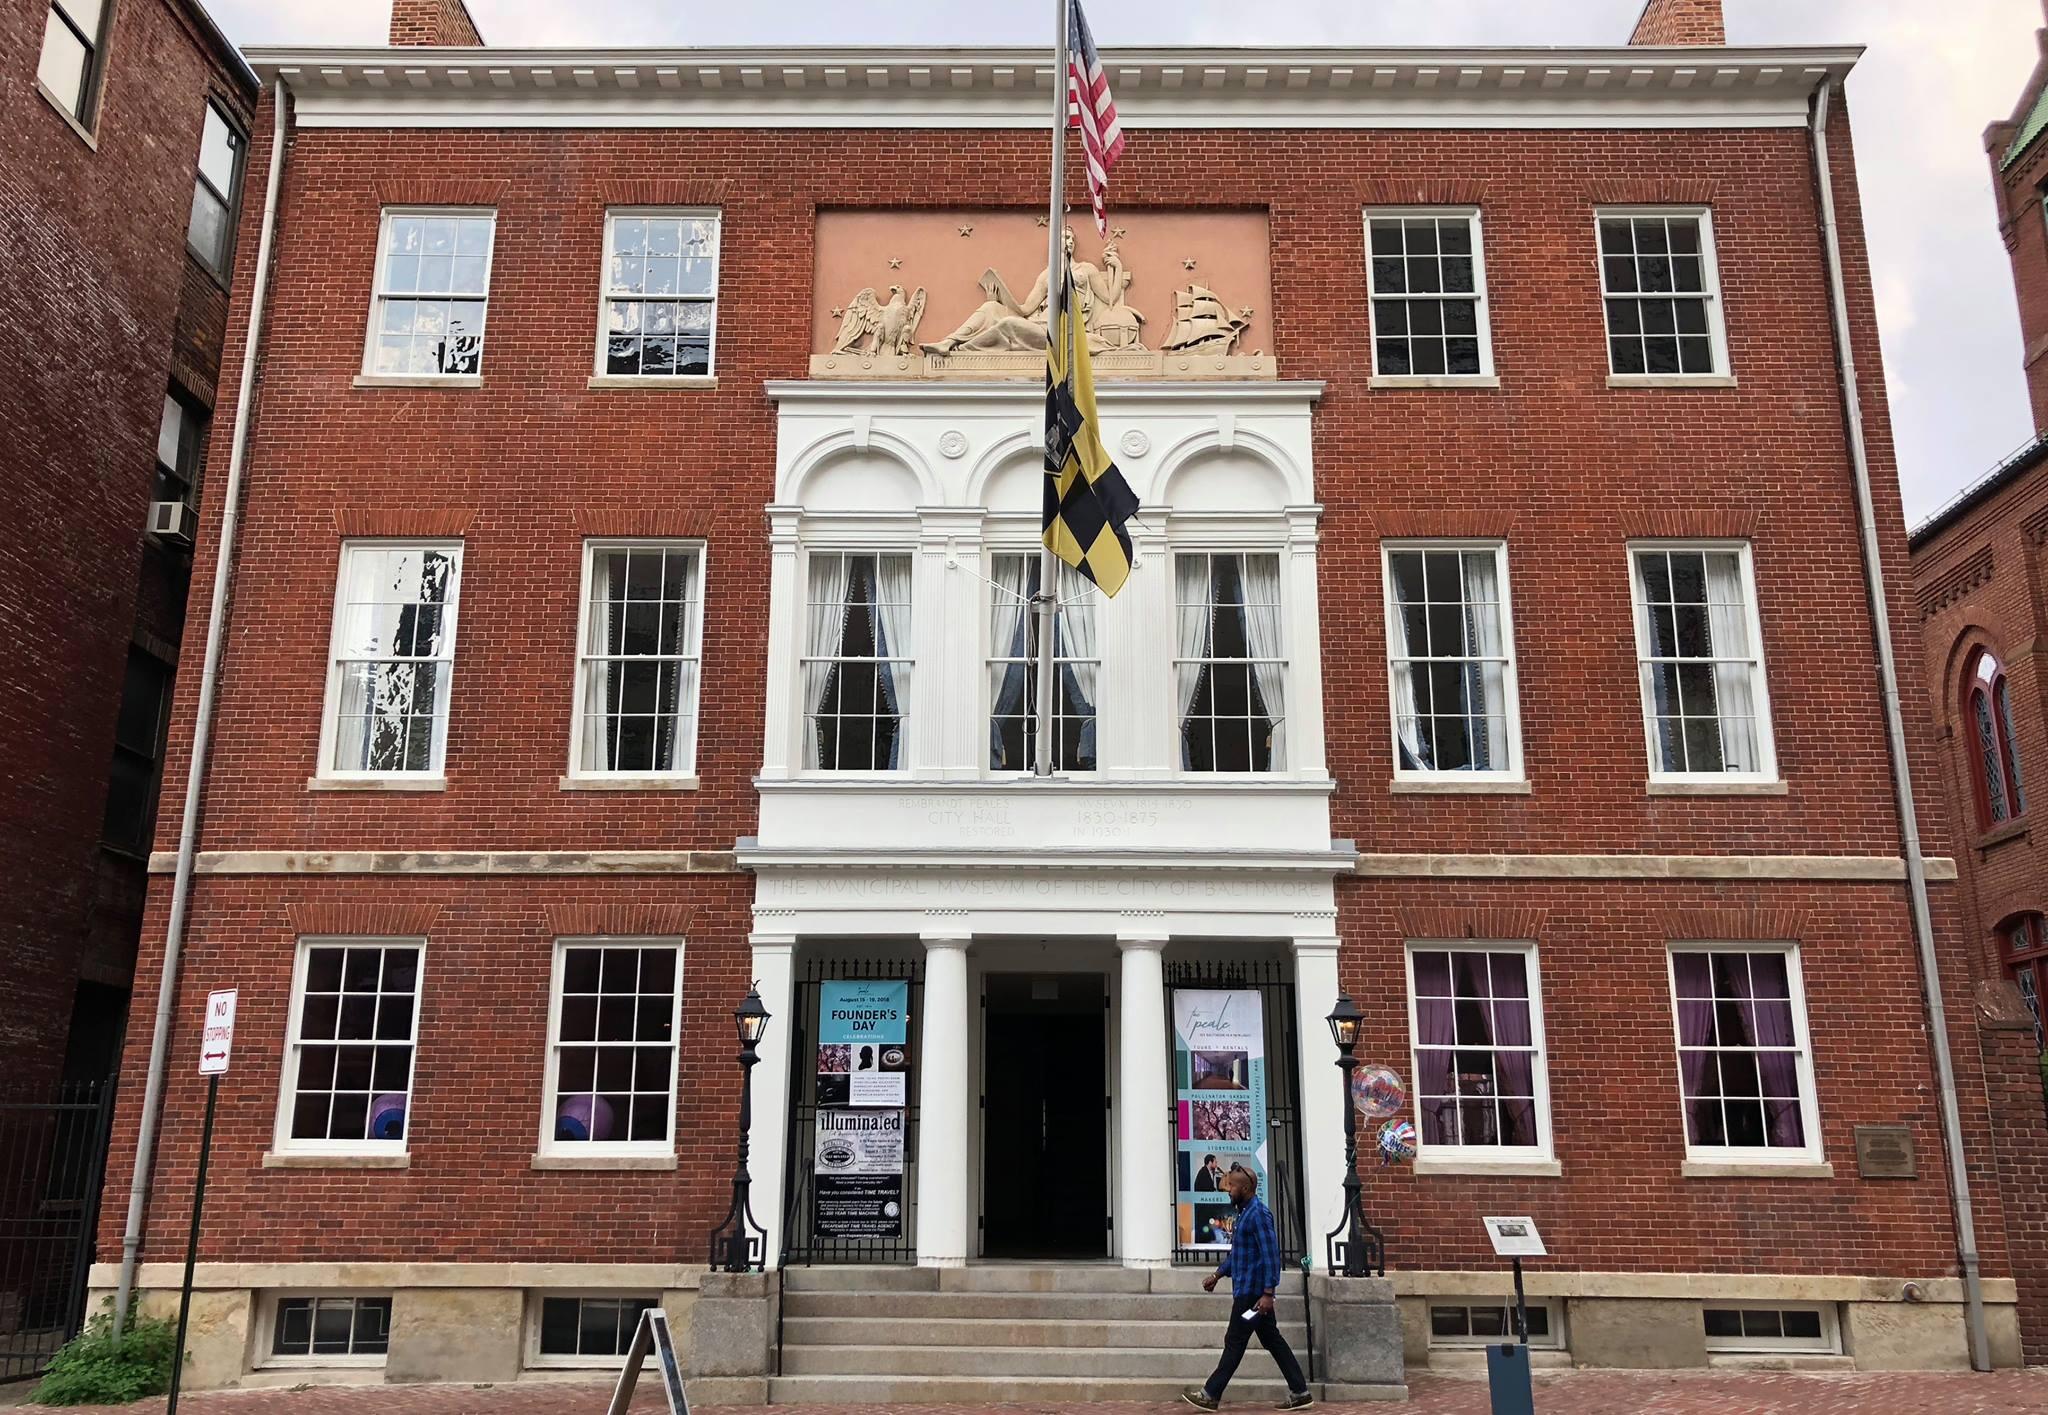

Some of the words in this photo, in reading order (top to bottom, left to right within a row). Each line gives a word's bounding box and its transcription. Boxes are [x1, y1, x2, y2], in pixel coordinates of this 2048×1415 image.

[928, 811, 963, 824] CITY
[973, 811, 1011, 824] HALL
[959, 826, 1015, 838] RESTORED
[769, 878, 807, 896] THE
[1035, 879, 1064, 896] OF
[1072, 879, 1109, 896] THE
[1116, 879, 1162, 896] CITY
[1170, 879, 1200, 896] OF
[1205, 879, 1321, 898] BALTIMORE
[215, 1001, 227, 1017] NO
[831, 1009, 897, 1021] FOUNDER'S
[1189, 994, 1231, 1040] peale
[852, 1021, 876, 1031] DAY
